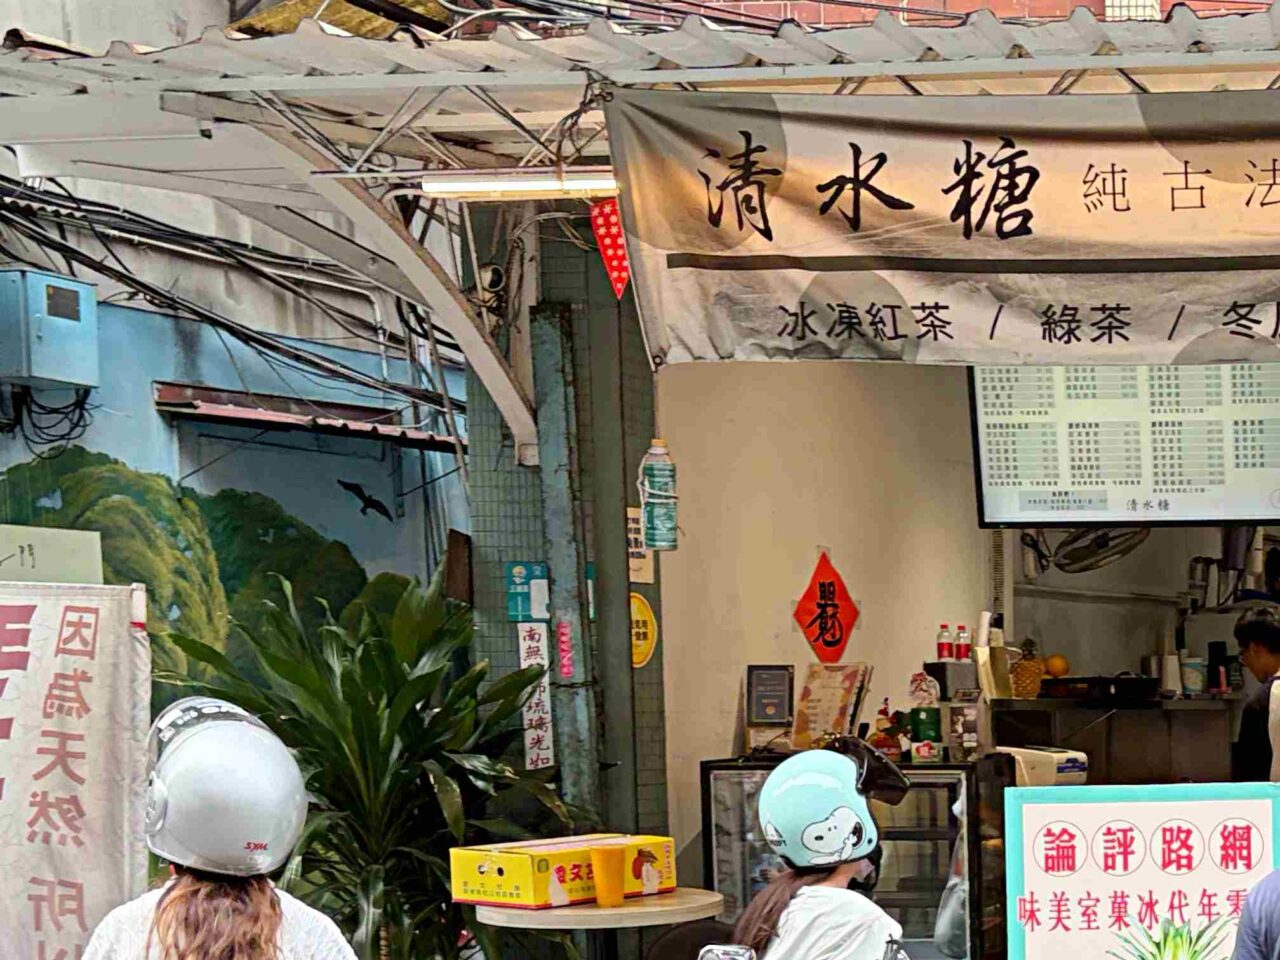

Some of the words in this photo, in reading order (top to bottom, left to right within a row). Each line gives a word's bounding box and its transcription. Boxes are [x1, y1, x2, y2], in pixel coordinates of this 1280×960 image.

[698, 129, 1041, 242] 清水糖
[1041, 303, 1132, 345] 綠茶
[522, 626, 551, 769] 南無琉璃光如
